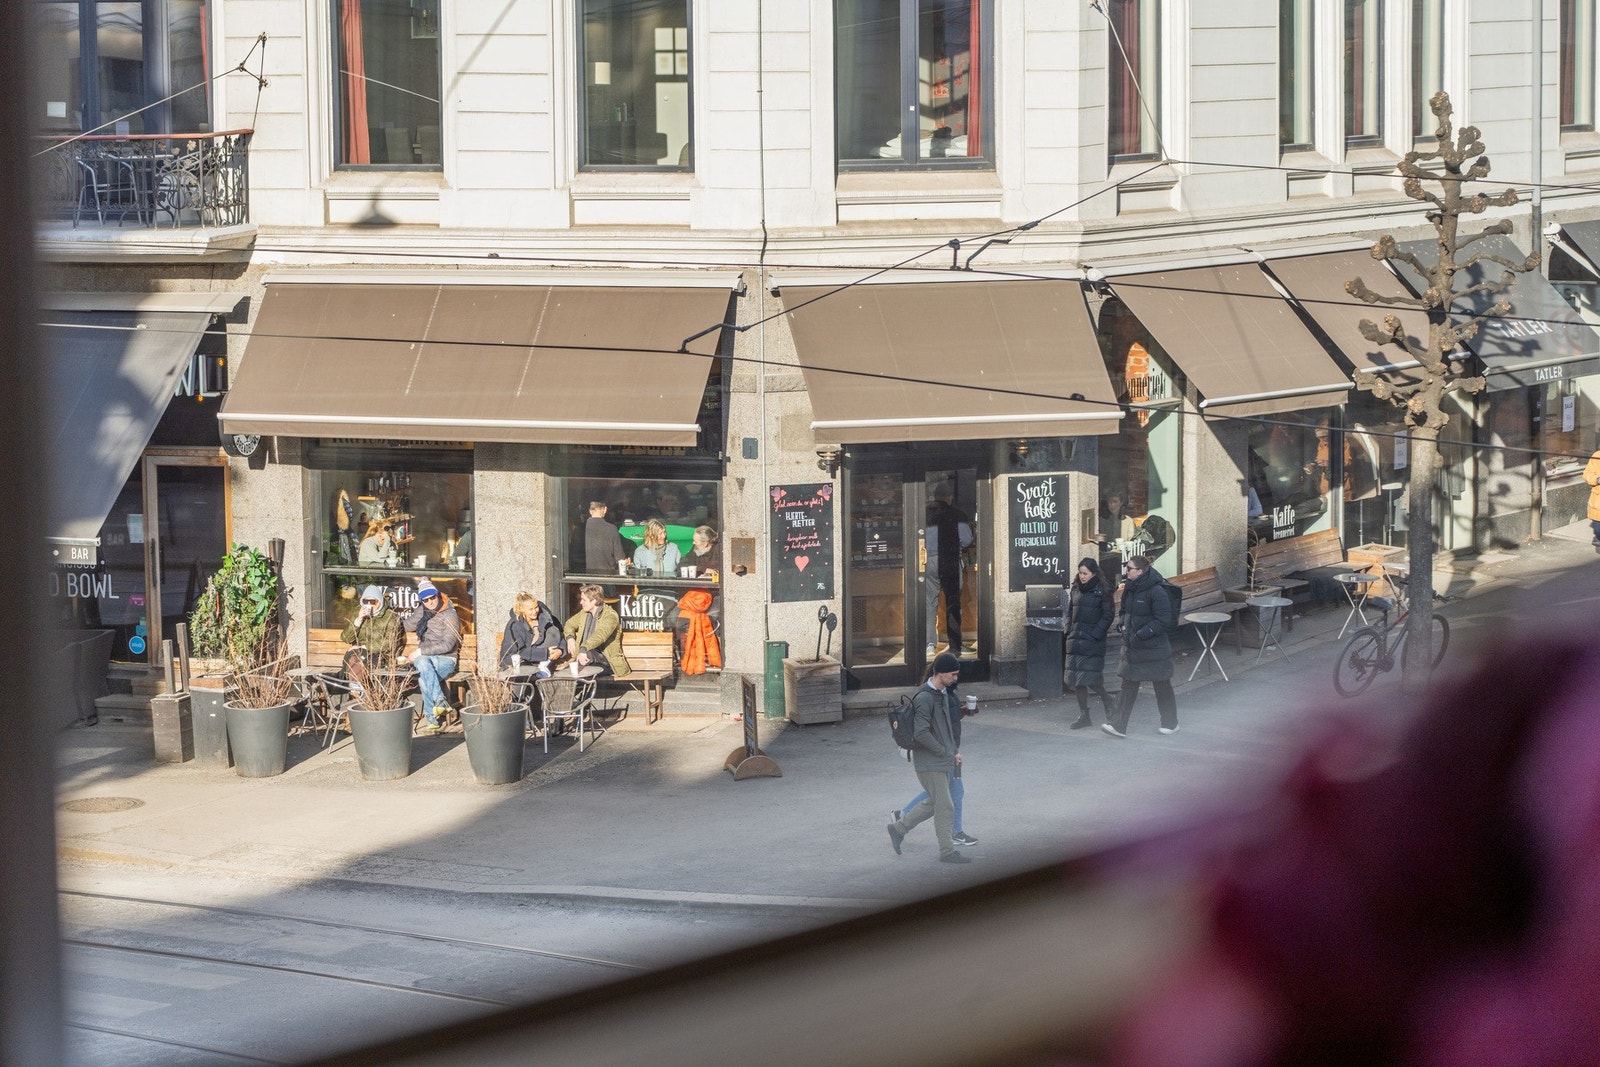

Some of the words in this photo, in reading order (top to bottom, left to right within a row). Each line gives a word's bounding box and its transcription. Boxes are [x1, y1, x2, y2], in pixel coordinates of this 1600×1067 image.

[1492, 319, 1554, 338] TATLER
[1534, 366, 1563, 381] TATLER
[1017, 477, 1057, 503] Svart
[1025, 497, 1057, 519] kaffe
[1273, 504, 1295, 528] Kaffe
[1020, 522, 1046, 534] ALLTID
[1048, 521, 1058, 533] TO
[71, 547, 89, 560] BAR
[67, 572, 120, 599] BOWL
[619, 594, 665, 618] Kaffe
[620, 618, 665, 631] brenneriet
